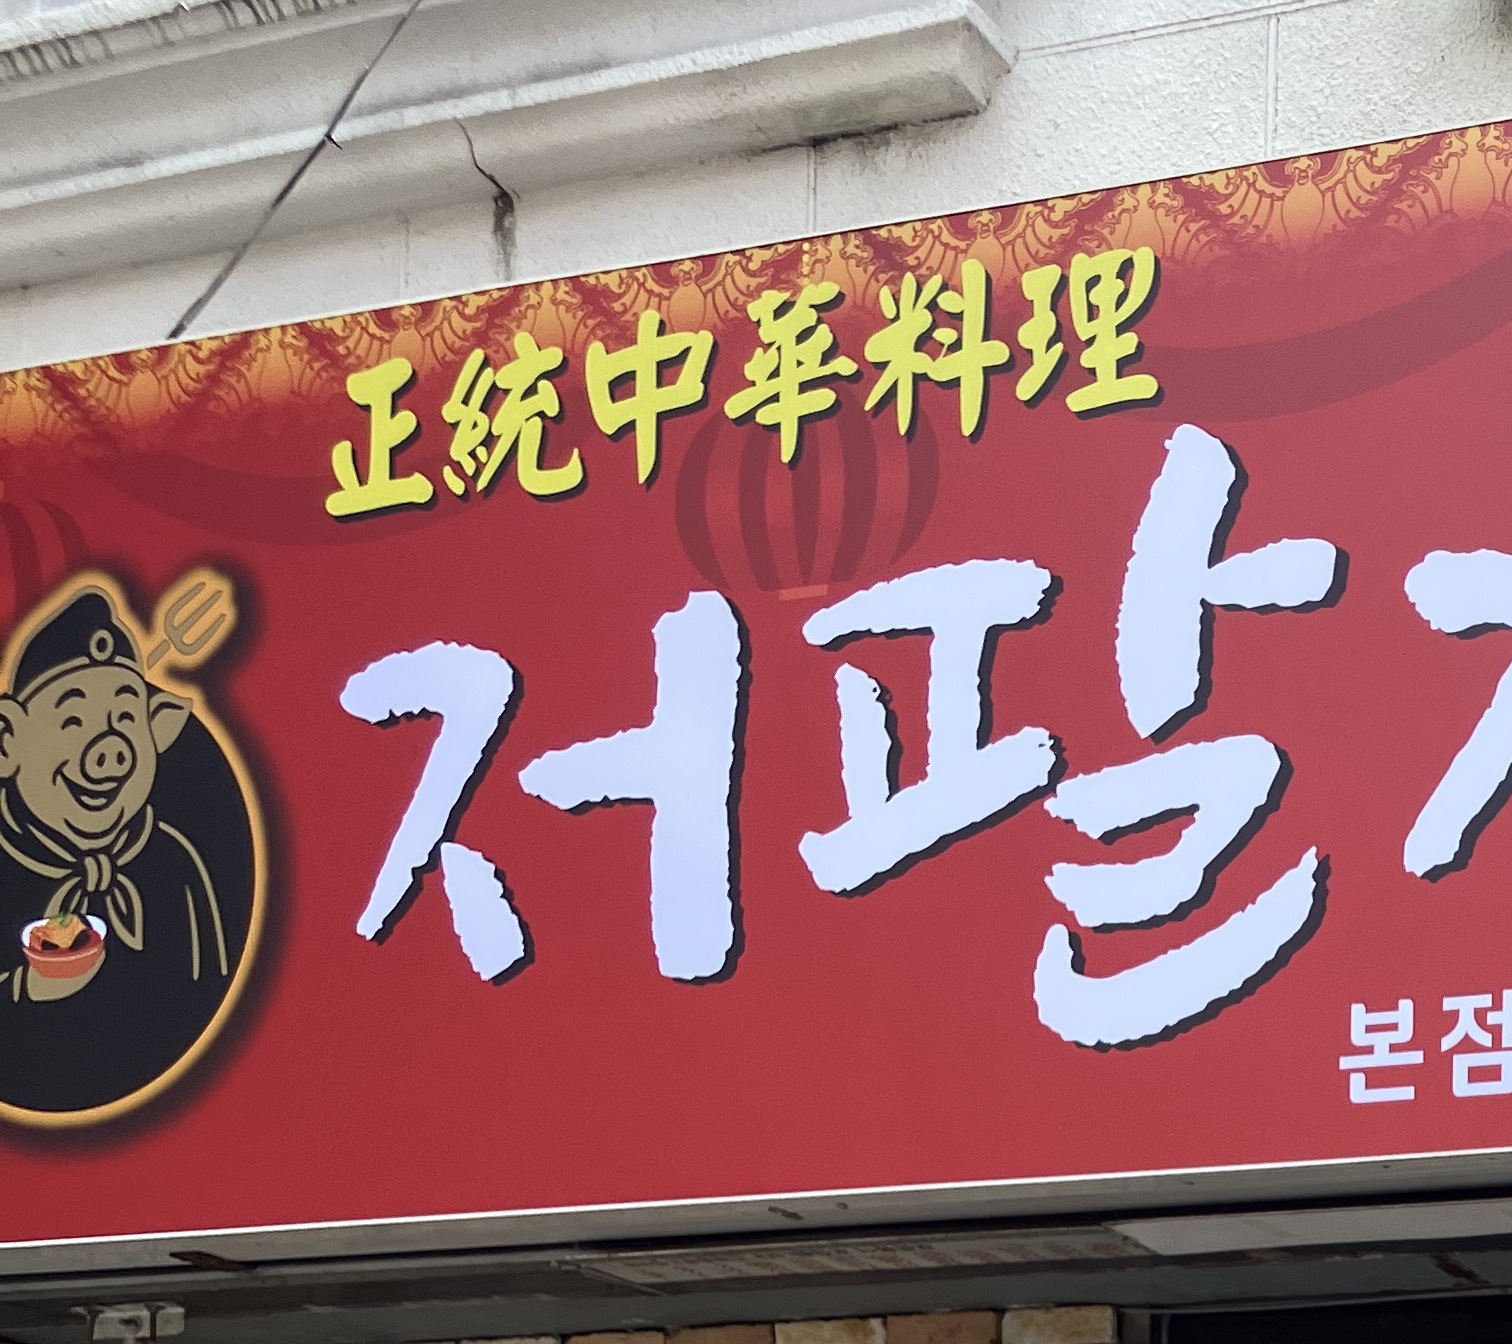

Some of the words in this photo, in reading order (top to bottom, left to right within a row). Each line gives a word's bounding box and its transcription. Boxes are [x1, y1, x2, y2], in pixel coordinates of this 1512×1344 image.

[325, 247, 1158, 517] 正統中華料理
